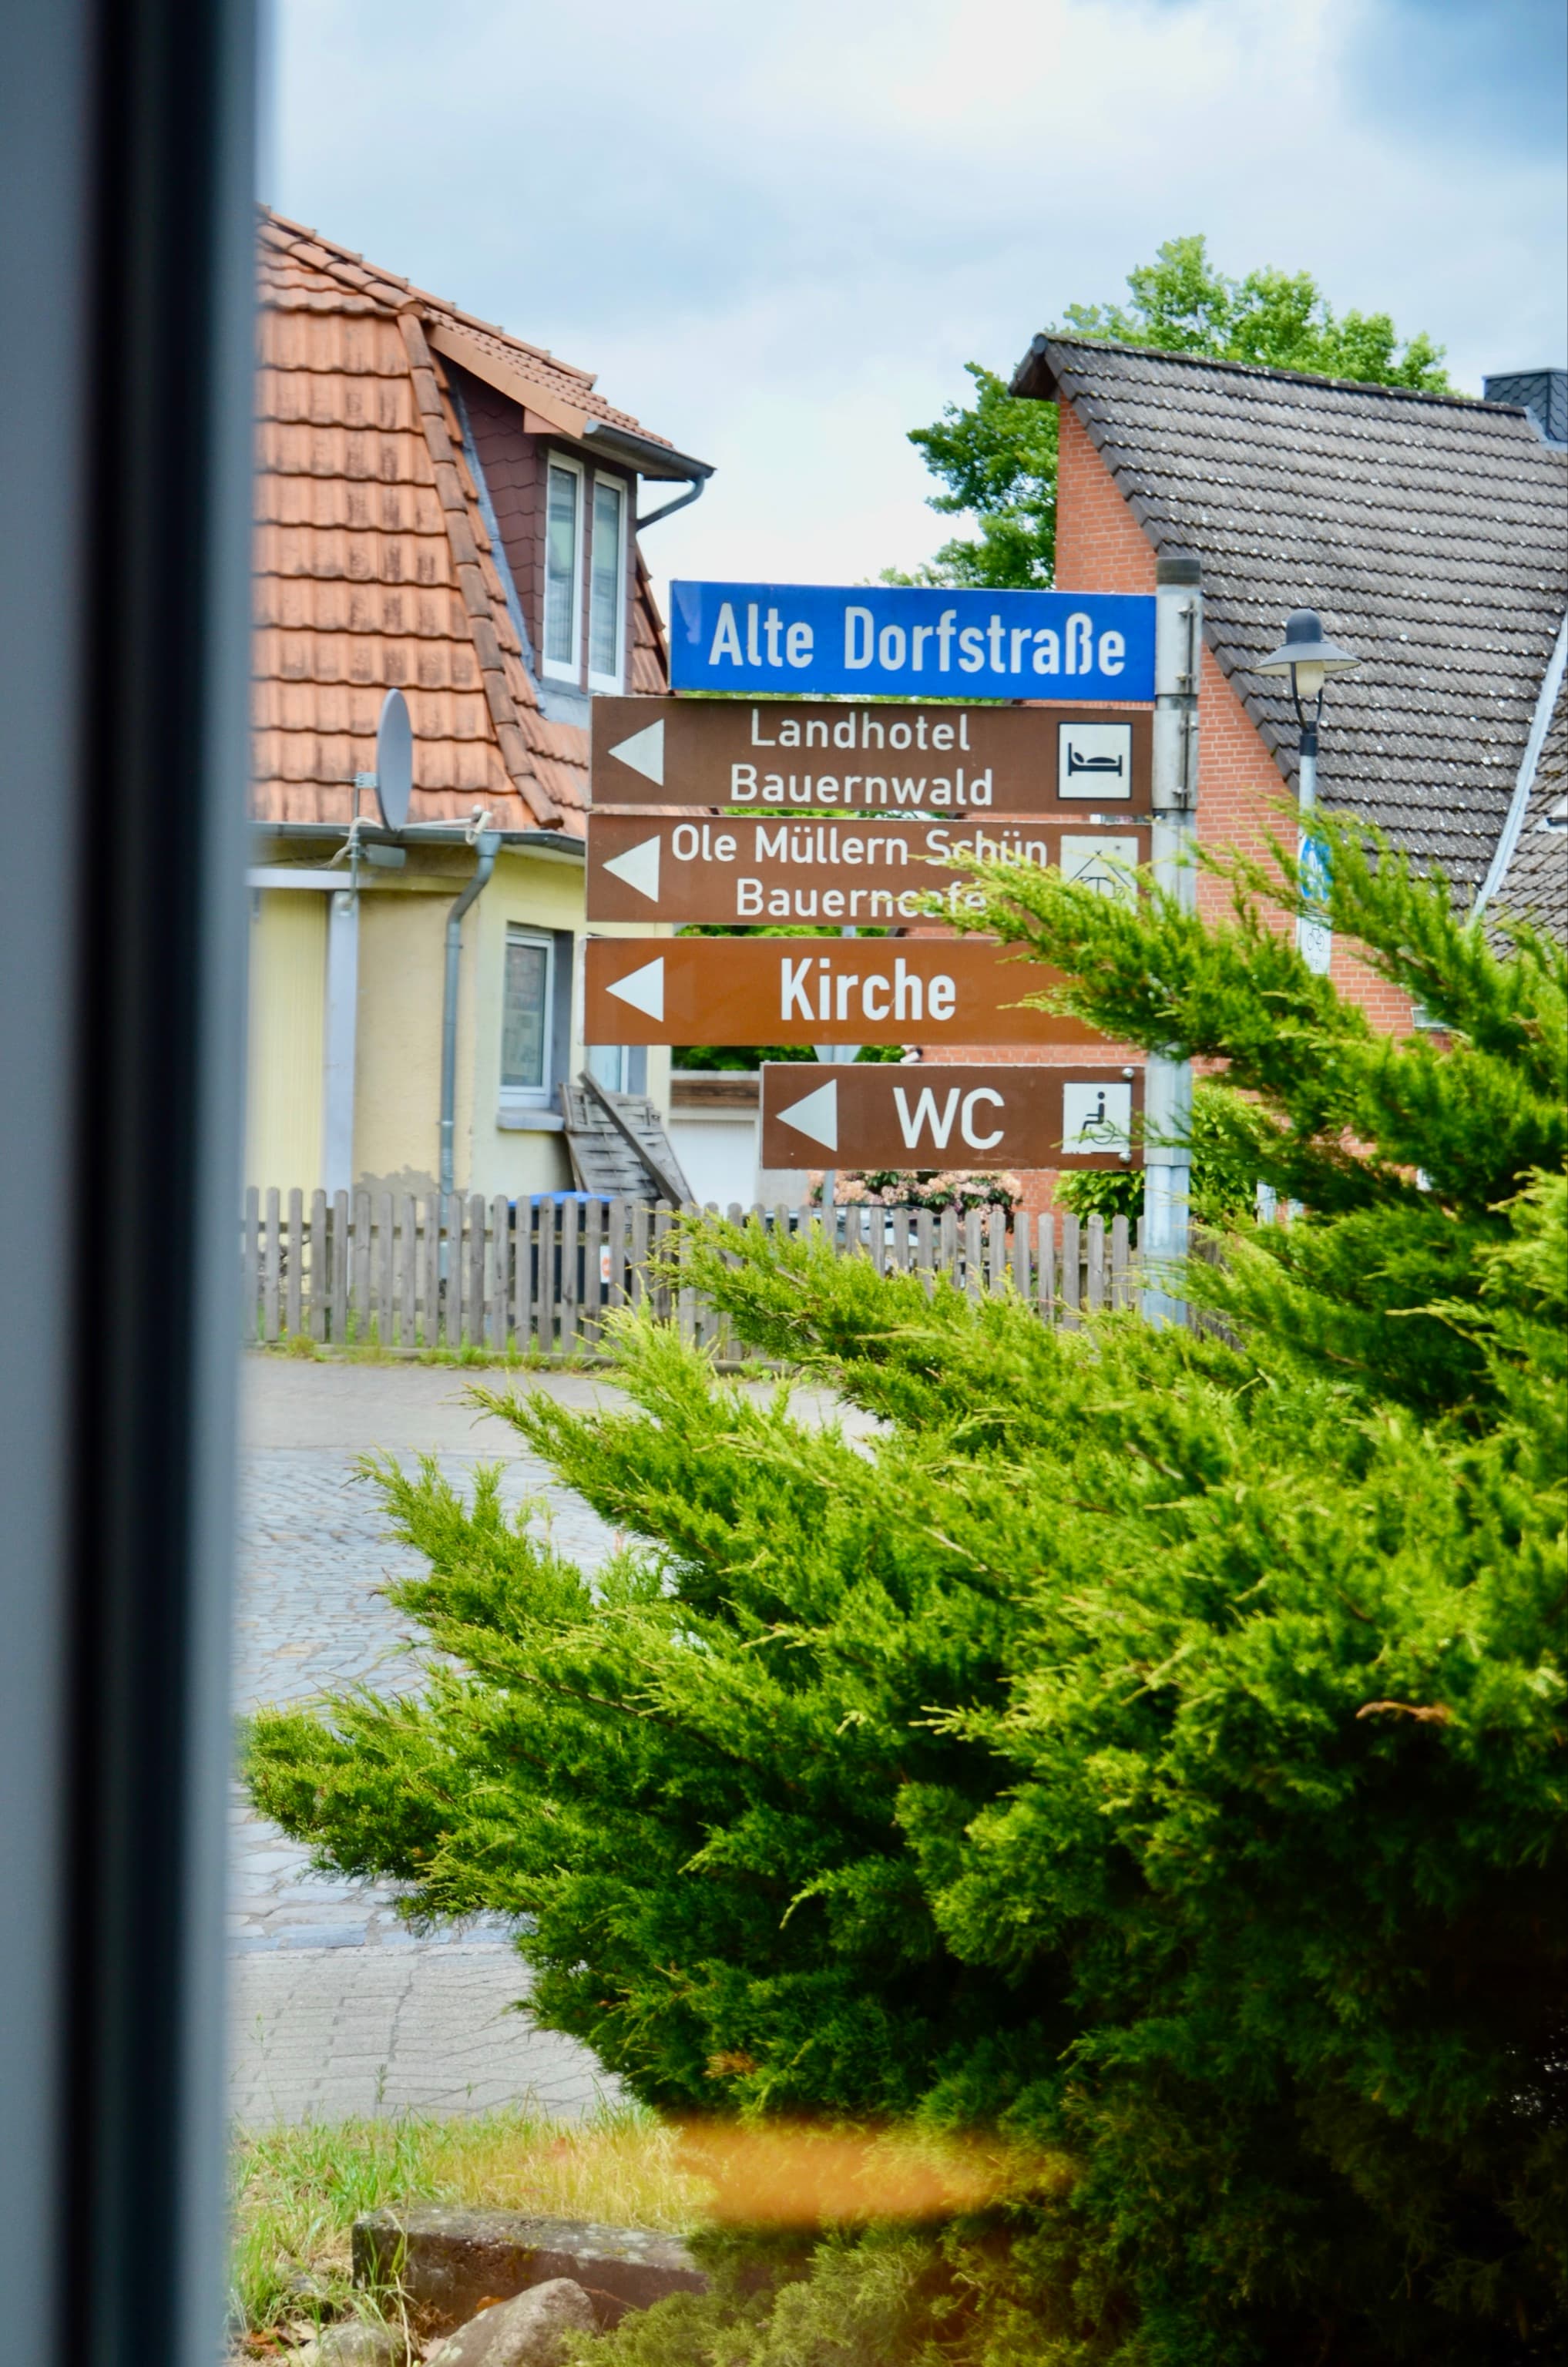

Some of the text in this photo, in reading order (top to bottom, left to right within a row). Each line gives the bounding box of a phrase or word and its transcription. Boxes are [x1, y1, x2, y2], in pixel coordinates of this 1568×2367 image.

[709, 603, 1126, 676] Alte Dorfstraße
[751, 709, 970, 751] Landhotel
[730, 764, 993, 806] Bauernwald
[672, 823, 1048, 869] Ole Müllern Schün
[781, 957, 956, 1021] Kirche
[893, 1086, 1005, 1150] WC
